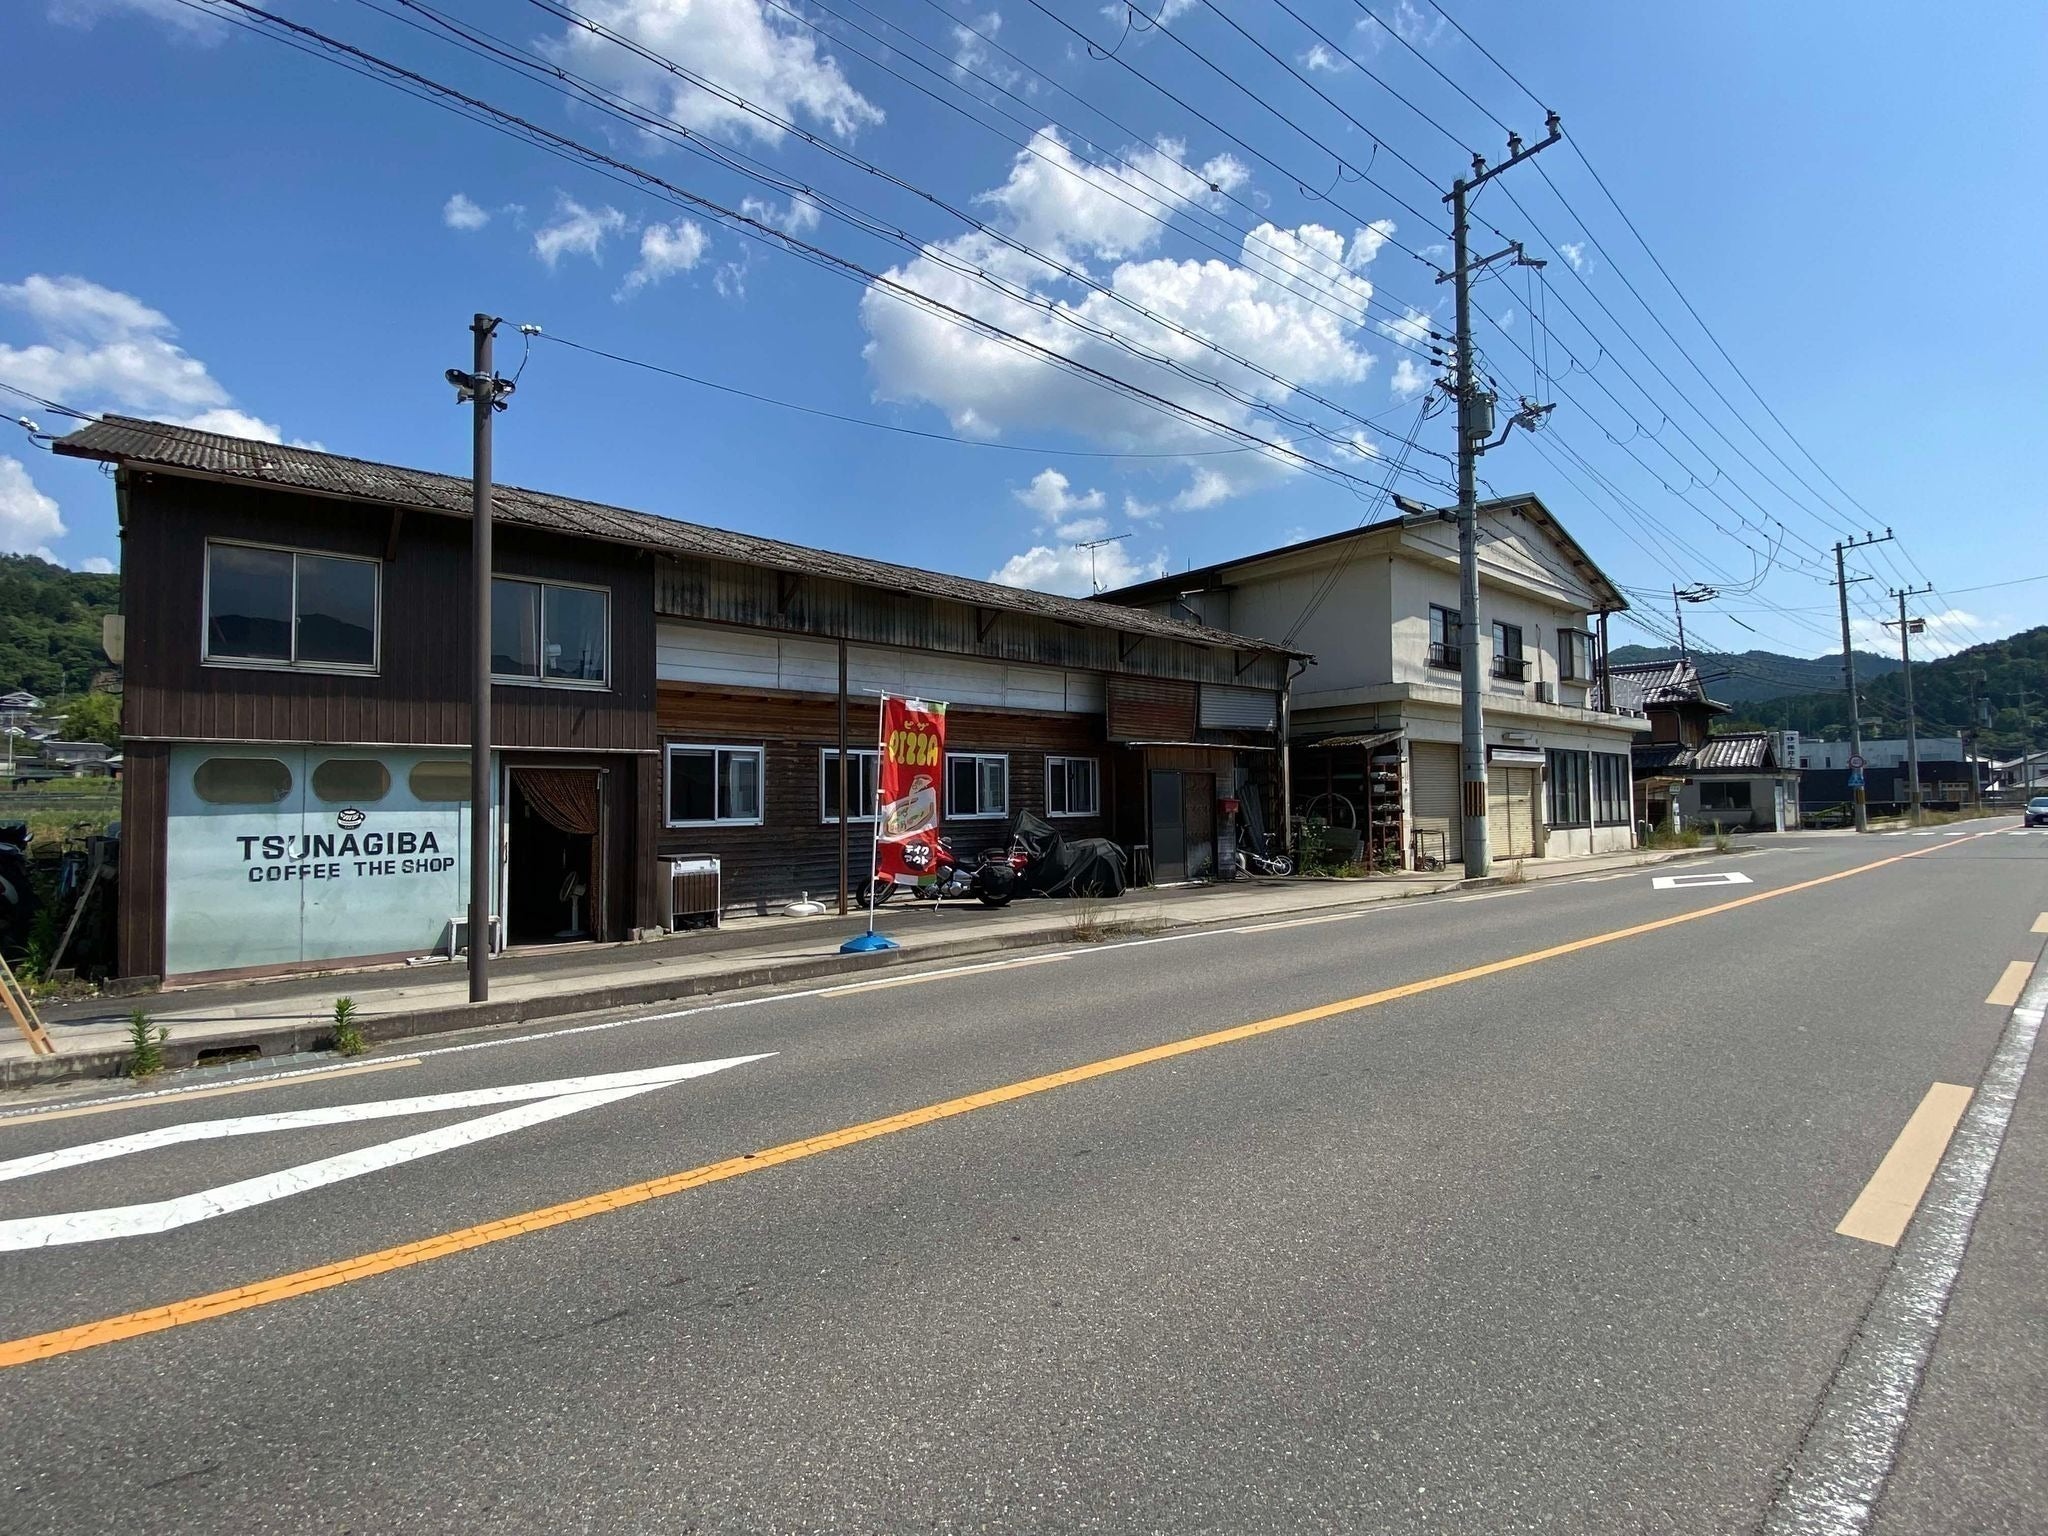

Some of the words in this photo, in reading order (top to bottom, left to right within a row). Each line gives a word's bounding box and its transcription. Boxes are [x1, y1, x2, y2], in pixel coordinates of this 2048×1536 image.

[904, 720, 930, 731] ピザ
[889, 730, 939, 767] PIZZA
[237, 831, 440, 861] TSUNAGIBA
[905, 844, 931, 856] テイク
[904, 854, 929, 865] アウト
[249, 863, 340, 883] COFFEE
[354, 860, 396, 877] THE
[401, 857, 455, 874] SHOP
